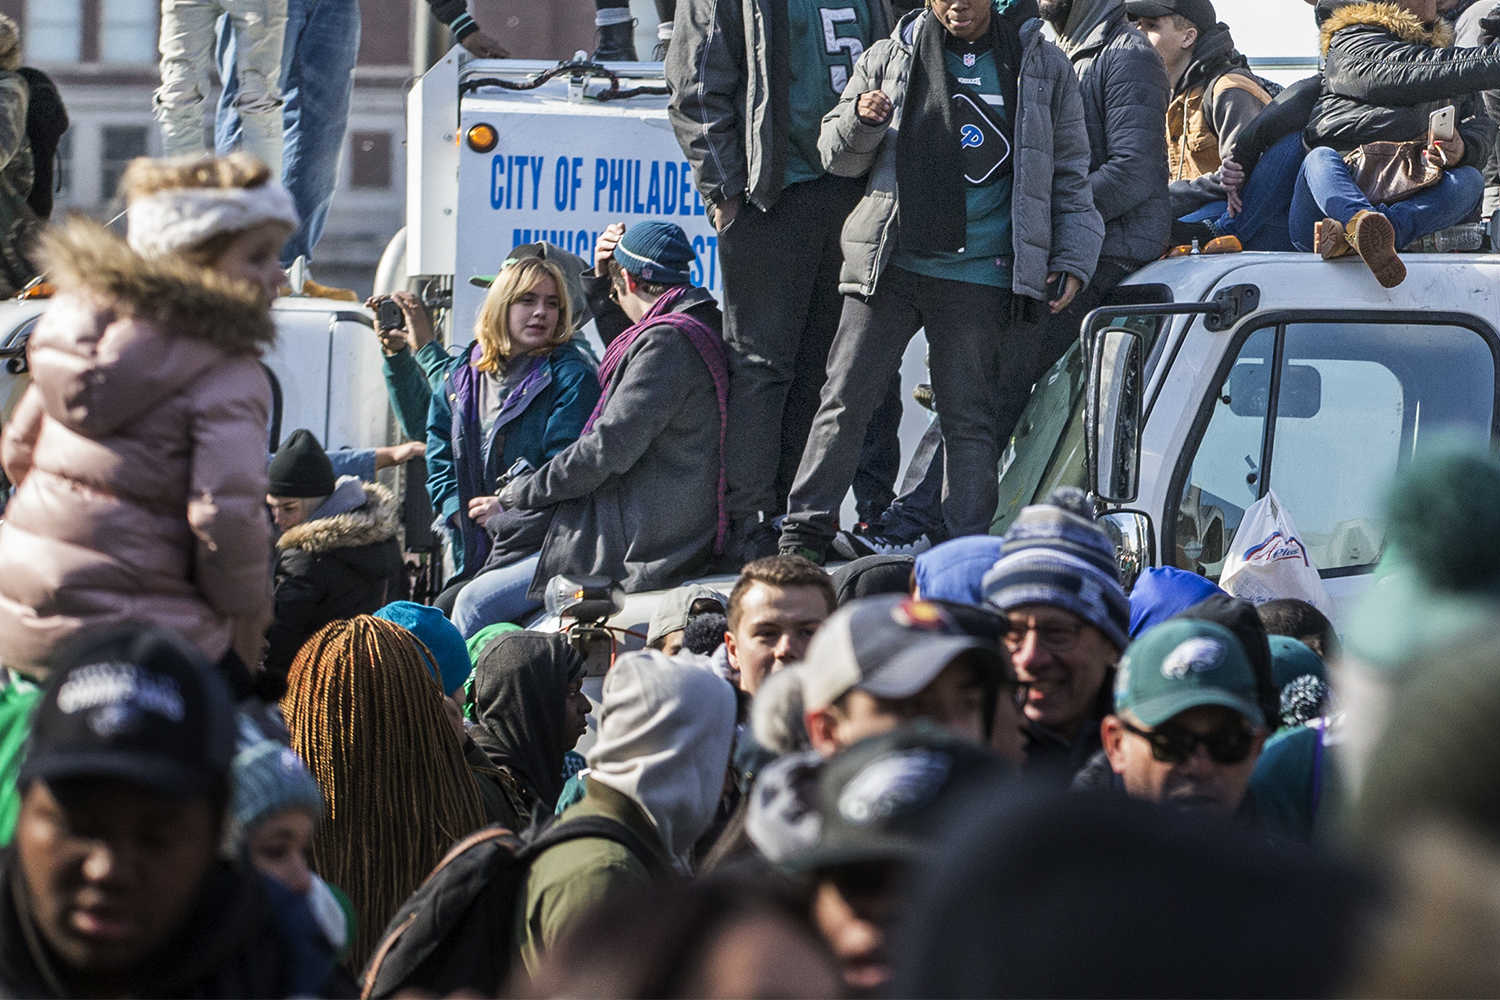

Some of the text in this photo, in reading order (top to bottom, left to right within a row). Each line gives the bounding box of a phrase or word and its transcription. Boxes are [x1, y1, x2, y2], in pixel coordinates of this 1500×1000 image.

[819, 7, 864, 95] 5
[490, 153, 544, 211] CITY
[554, 155, 584, 212] OF
